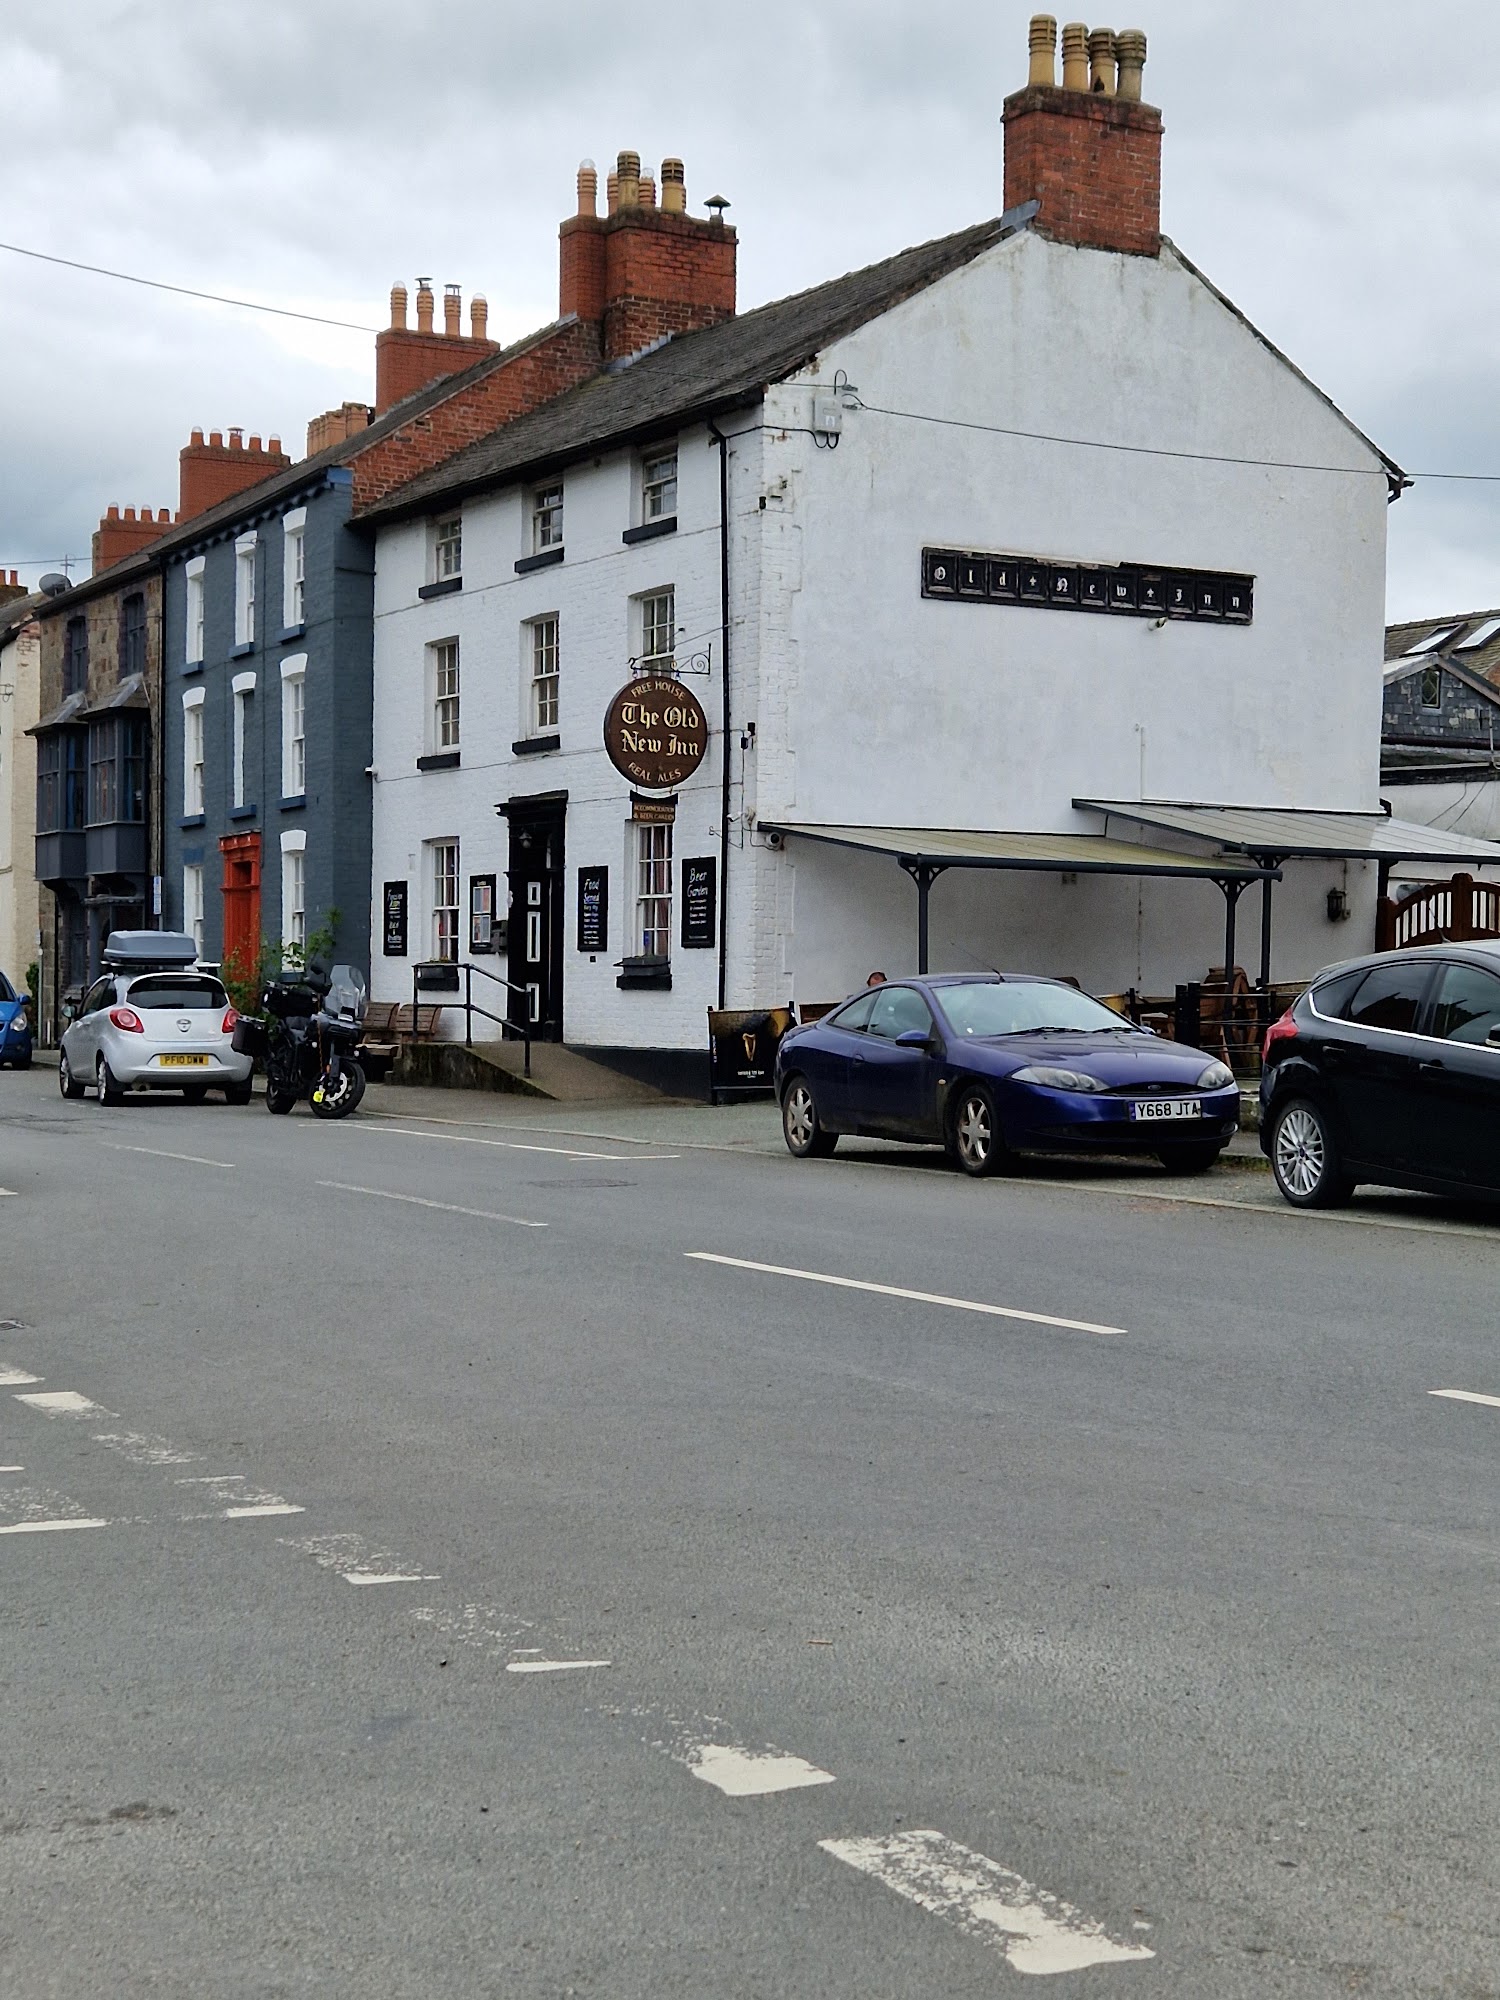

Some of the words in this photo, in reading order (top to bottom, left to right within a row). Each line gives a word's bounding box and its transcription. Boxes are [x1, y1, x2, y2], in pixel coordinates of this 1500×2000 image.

[933, 566, 1007, 587] Old
[1056, 577, 1127, 597] New
[1174, 588, 1240, 609] Inn
[630, 682, 652, 698] FREE
[654, 680, 686, 701] HOUSE
[621, 702, 660, 729] The
[663, 707, 699, 729] Old
[620, 729, 662, 753] New
[666, 734, 699, 756] Inn
[628, 762, 652, 781] REAL
[657, 768, 682, 783] ALES
[689, 867, 707, 883] Beer
[583, 878, 600, 892] Food
[687, 883, 709, 898] Garden
[164, 1055, 185, 1064] PF10
[1137, 1103, 1172, 1118] Y668
[1175, 1102, 1199, 1116] JTA
